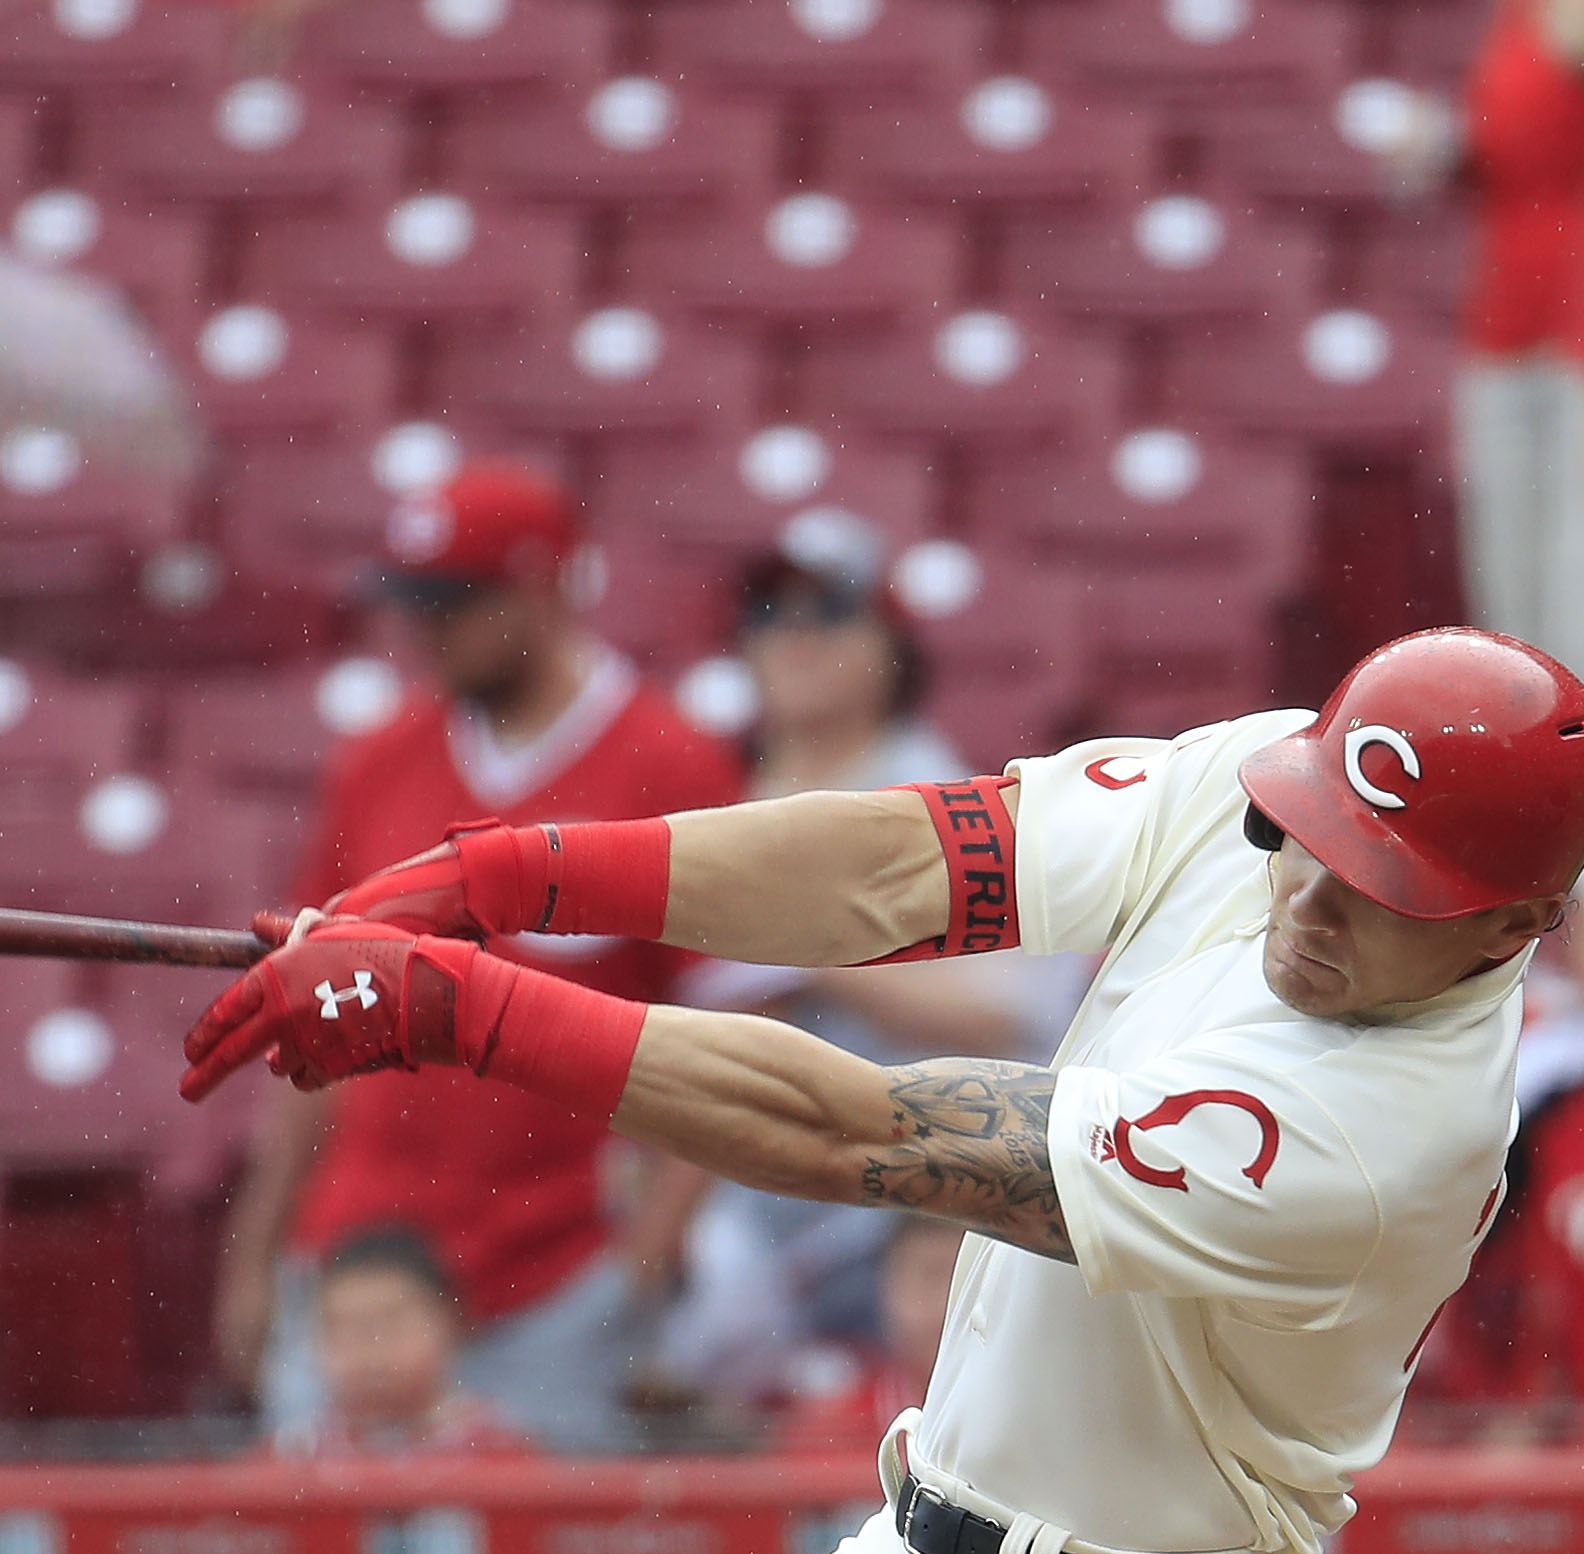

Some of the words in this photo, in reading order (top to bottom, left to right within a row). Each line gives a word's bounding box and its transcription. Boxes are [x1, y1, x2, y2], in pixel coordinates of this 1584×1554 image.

[1344, 724, 1421, 809] C
[934, 779, 1006, 950] IETRIC
[1113, 1089, 1280, 1193] C
